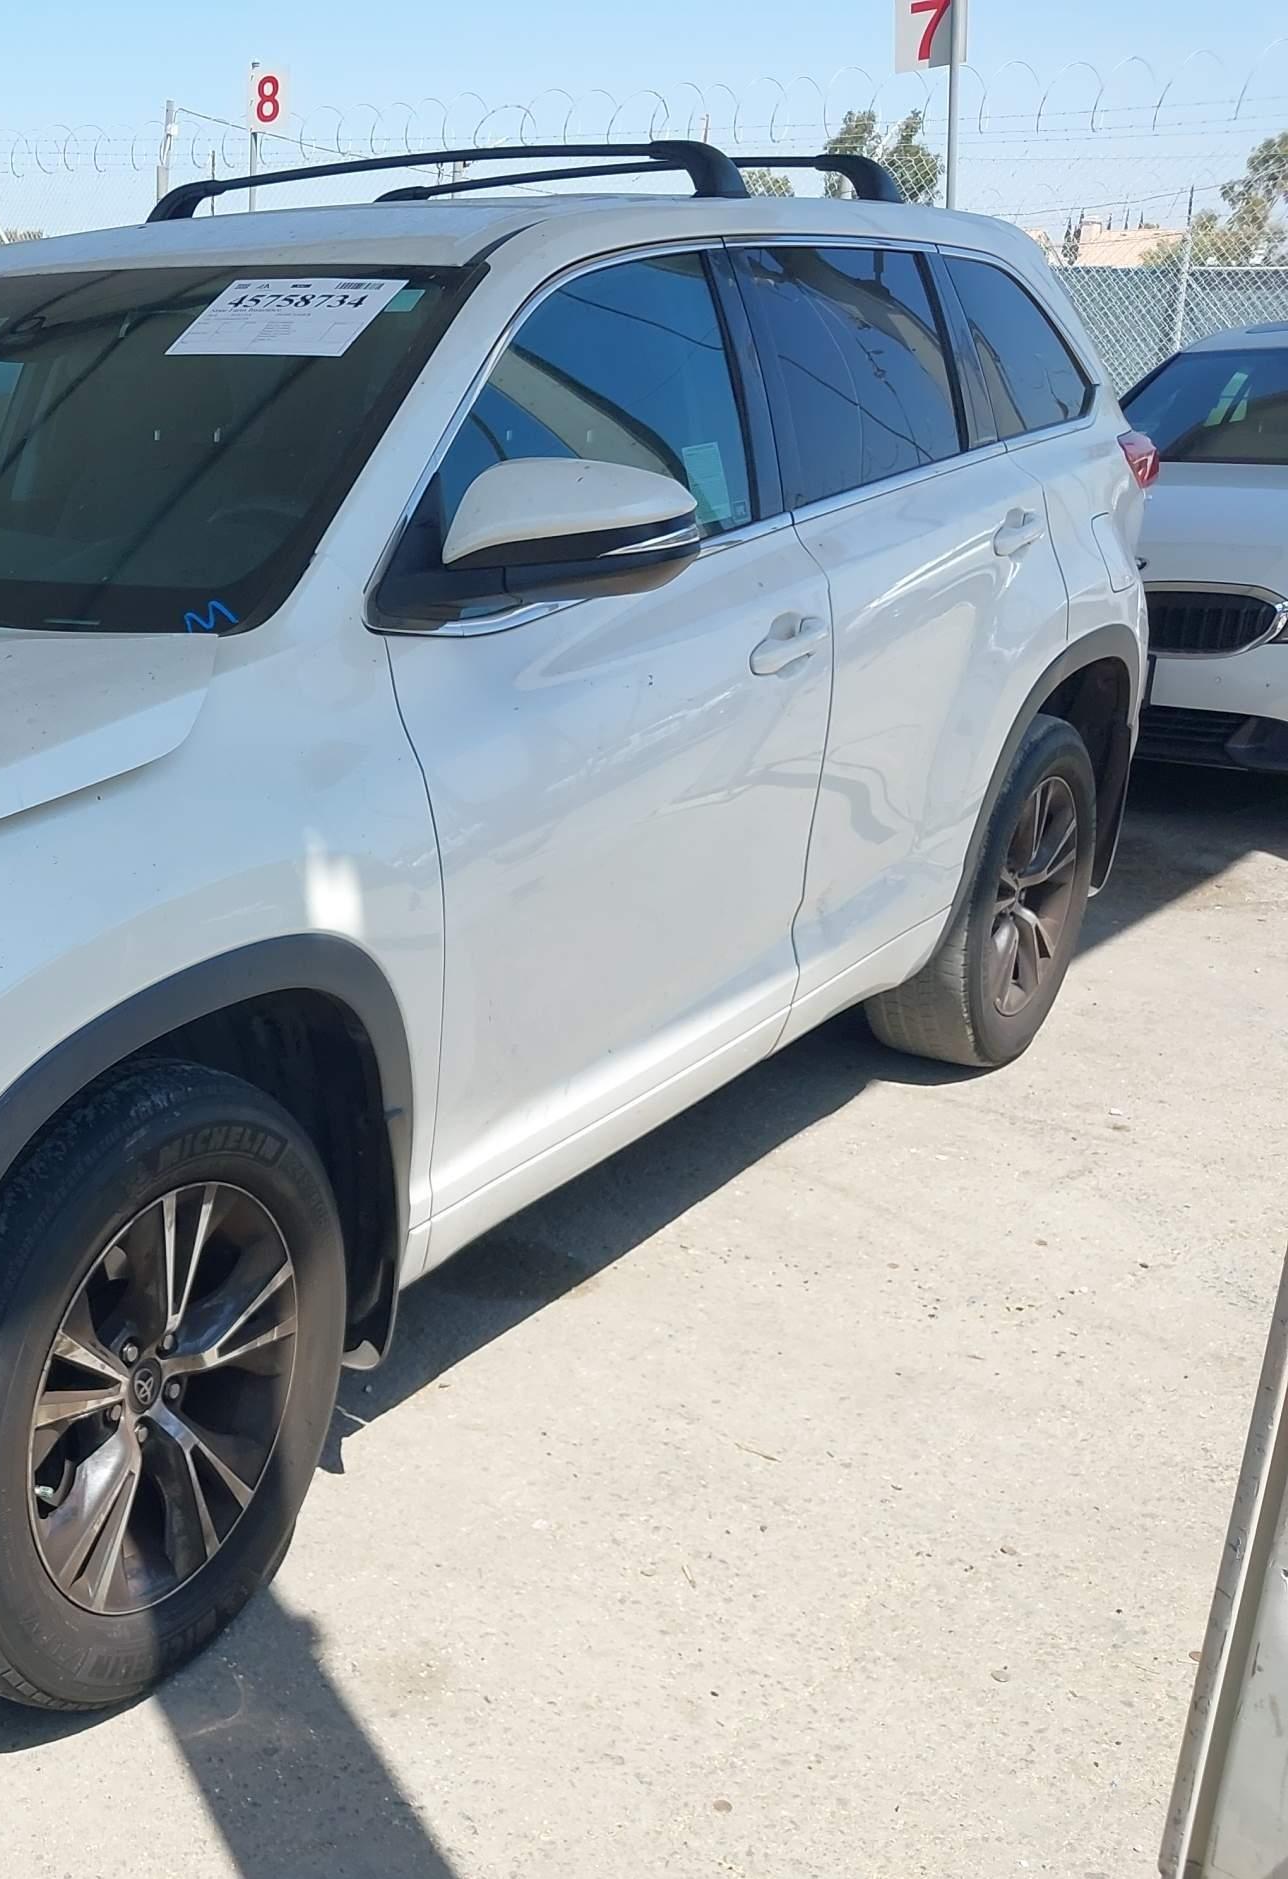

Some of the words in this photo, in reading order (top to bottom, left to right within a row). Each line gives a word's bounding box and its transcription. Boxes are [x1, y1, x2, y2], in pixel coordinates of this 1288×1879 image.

[910, 0, 951, 61] 7
[256, 75, 279, 123] 8
[227, 294, 369, 308] 45758734
[159, 1124, 282, 1172] MICHELIN
